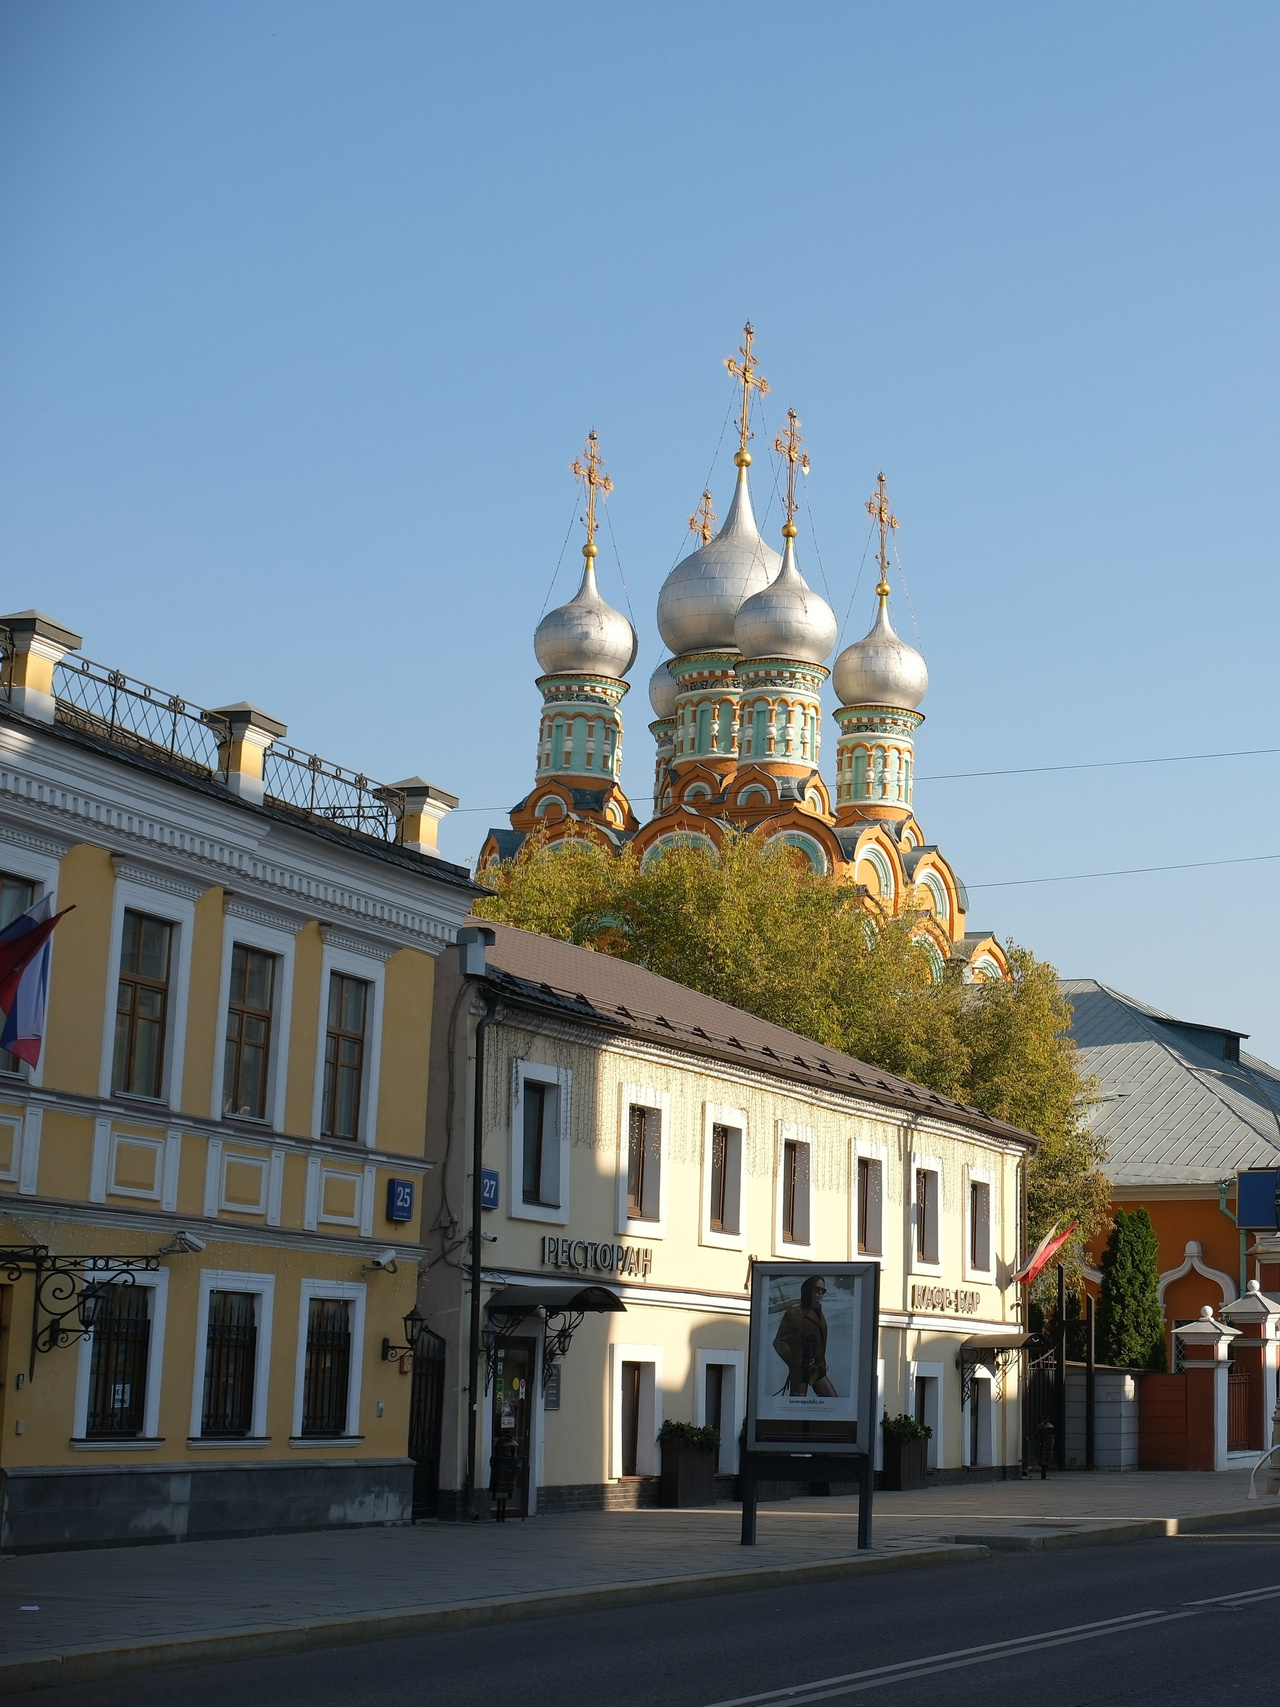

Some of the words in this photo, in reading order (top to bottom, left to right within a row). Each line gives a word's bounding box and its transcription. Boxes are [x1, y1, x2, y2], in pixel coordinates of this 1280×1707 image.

[396, 1186, 411, 1208] 25
[483, 1179, 497, 1199] 27
[542, 1235, 652, 1275] РЕСТОРАН
